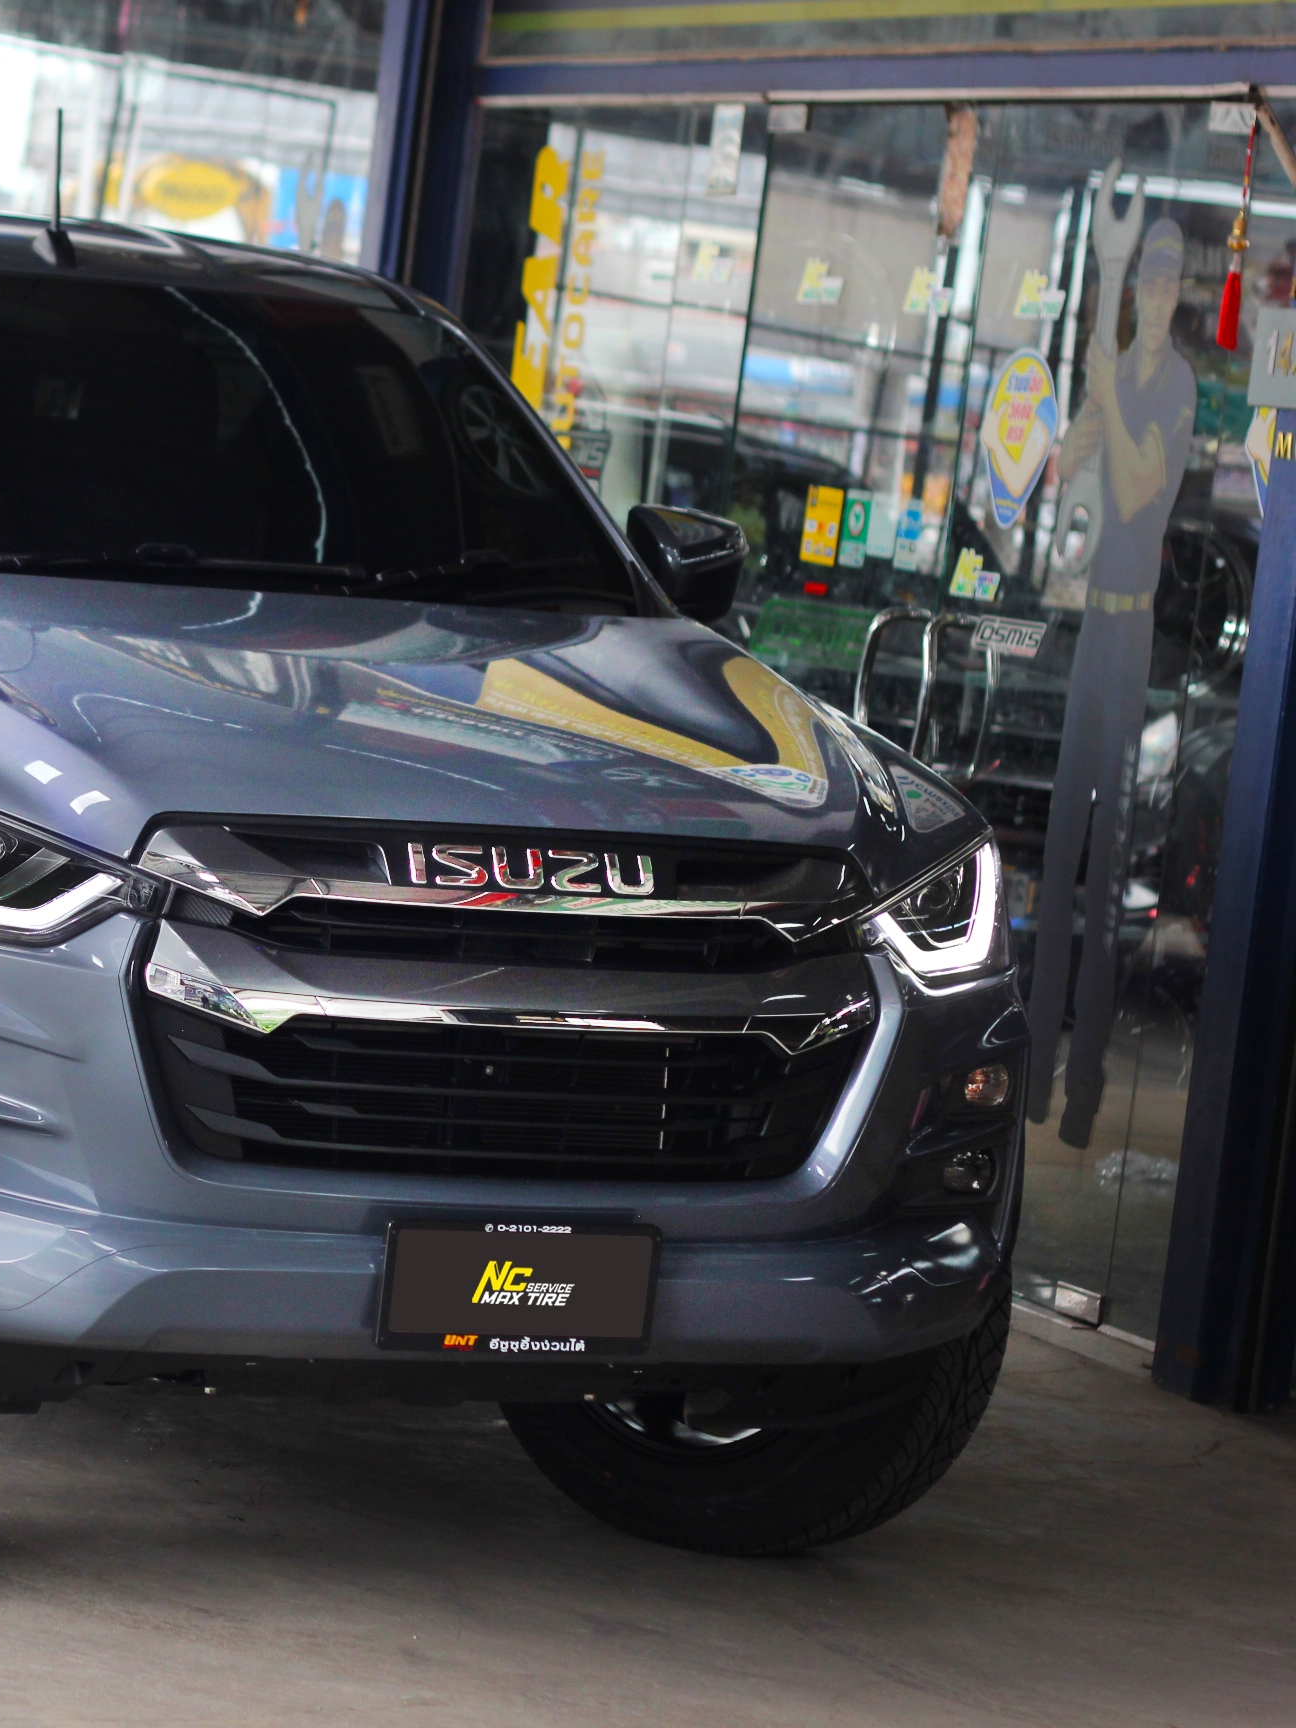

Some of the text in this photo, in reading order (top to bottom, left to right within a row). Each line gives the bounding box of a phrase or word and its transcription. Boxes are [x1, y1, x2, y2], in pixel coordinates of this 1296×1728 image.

[553, 148, 606, 451] UTOCARE
[407, 842, 655, 895] ISUZU
[497, 1224, 572, 1234] 0-2101-2222
